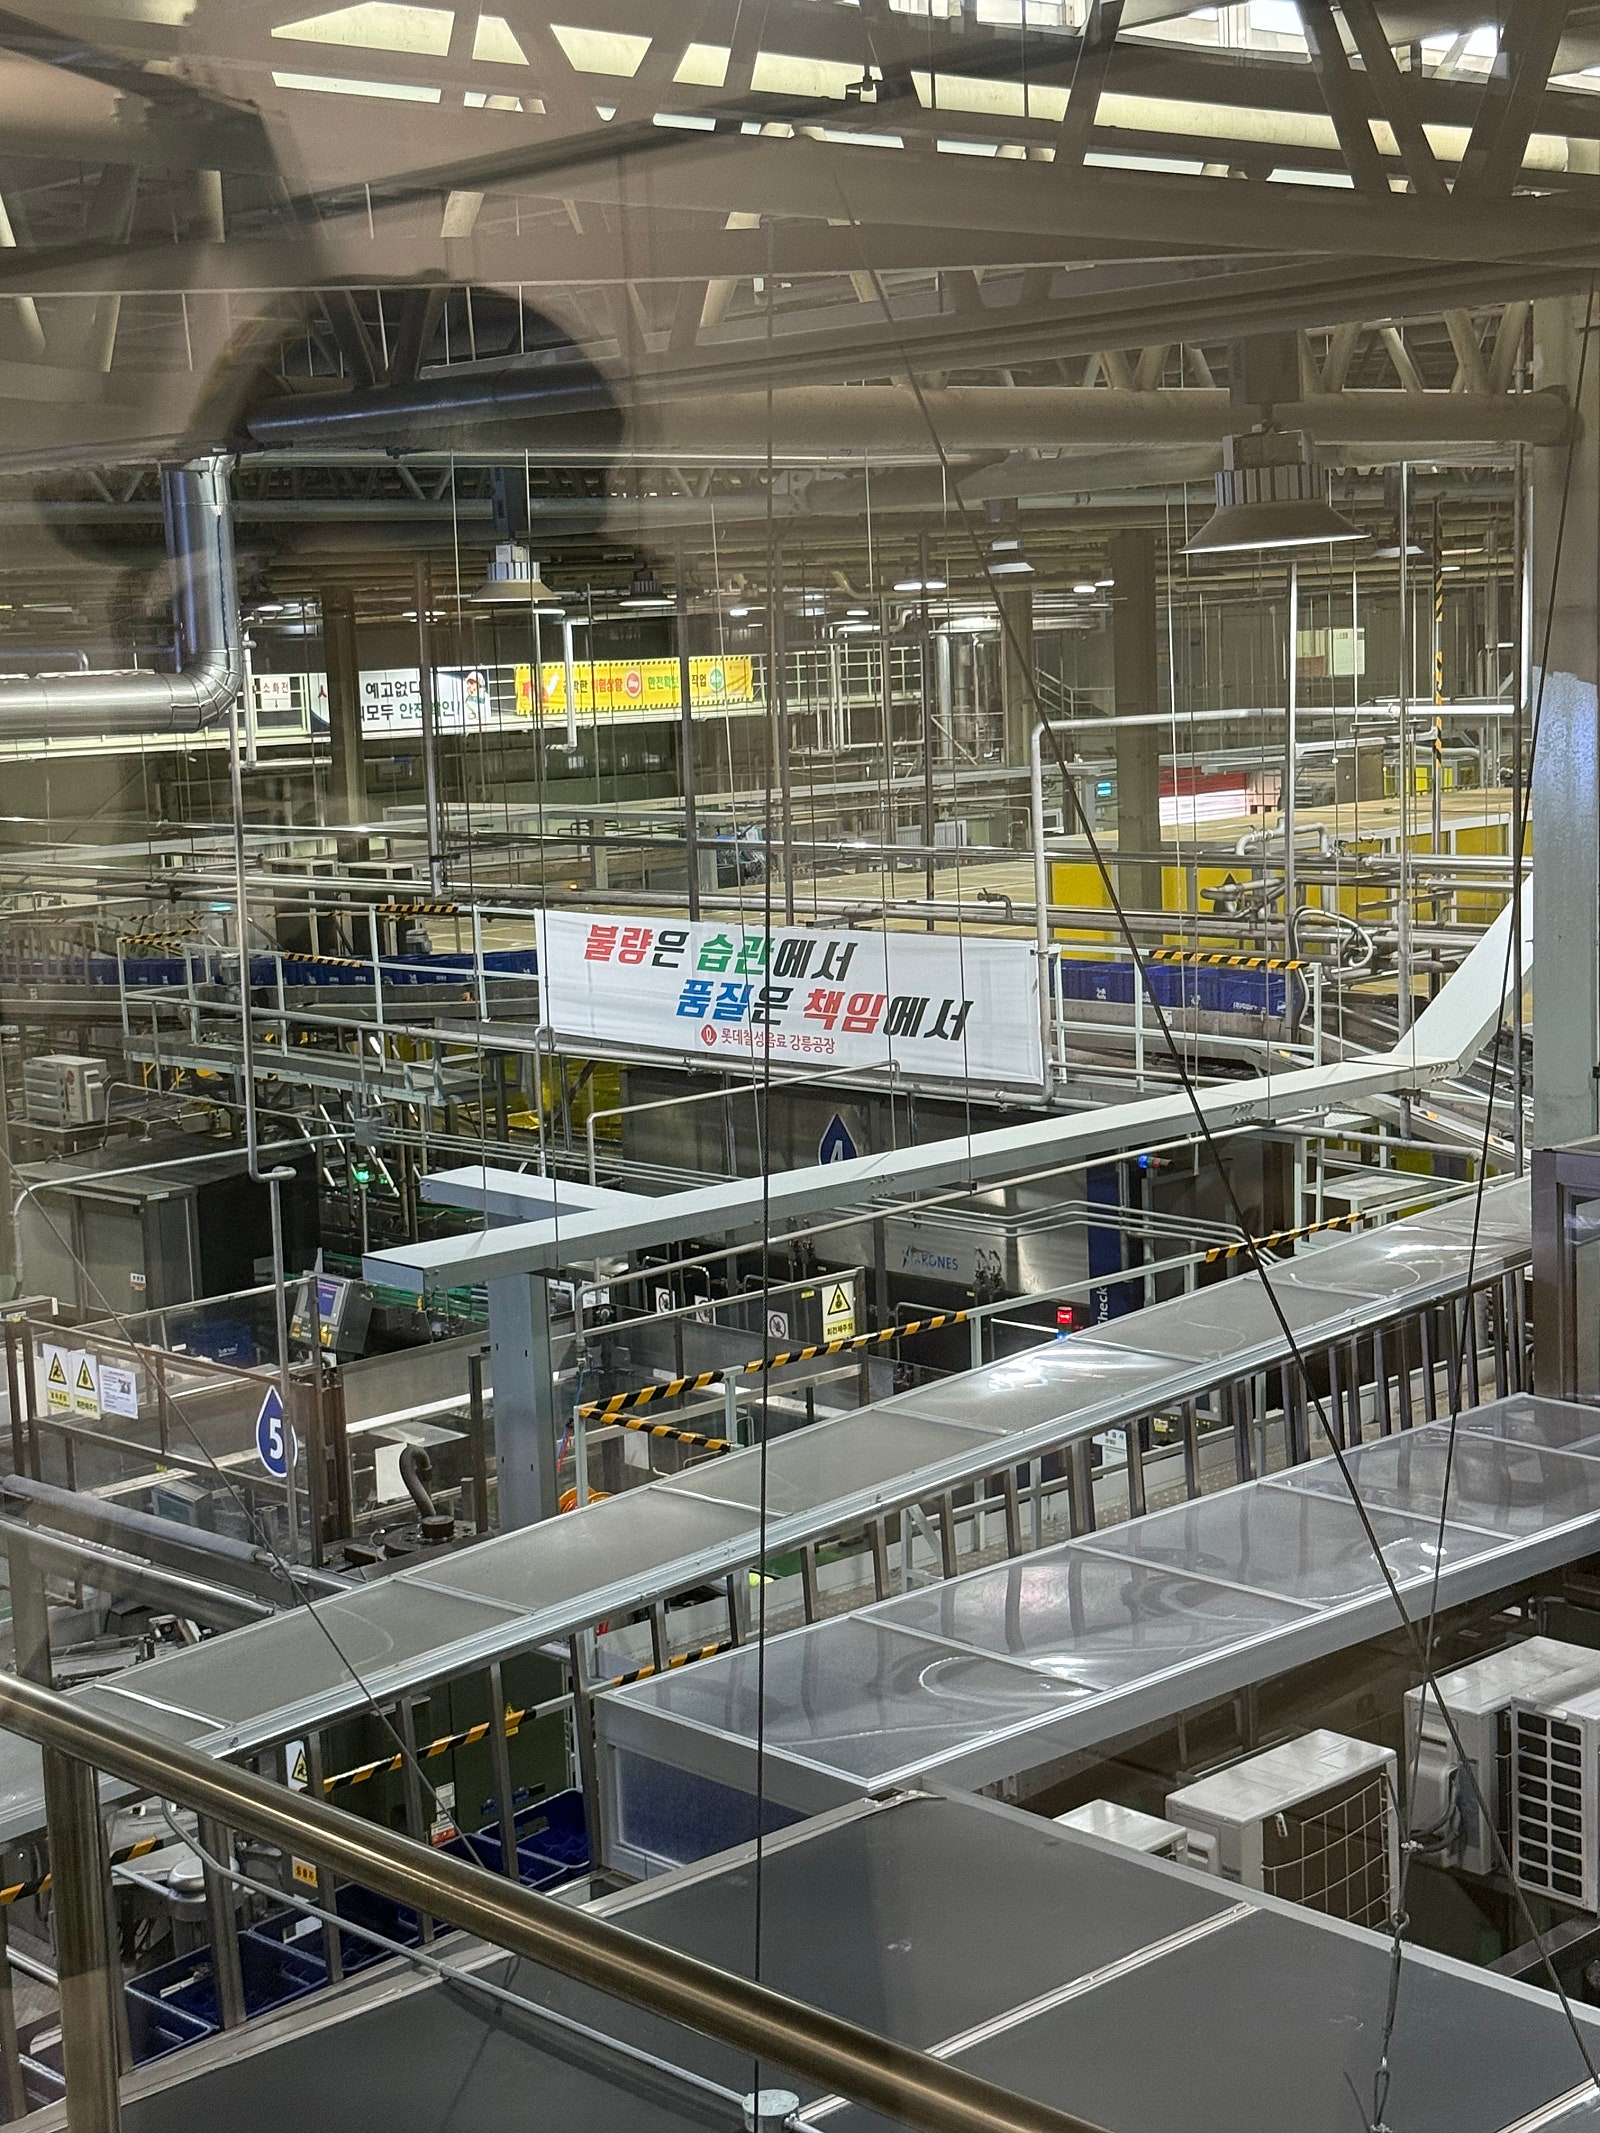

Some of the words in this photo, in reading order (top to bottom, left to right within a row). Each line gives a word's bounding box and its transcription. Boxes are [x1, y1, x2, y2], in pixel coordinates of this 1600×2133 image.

[263, 681, 289, 694] 소화전
[584, 924, 690, 969] 불량은
[696, 933, 859, 982] 습관에서
[675, 979, 794, 1026] 품질은
[803, 988, 975, 1042] 책임에서
[721, 1028, 788, 1049] 롯데칠성음료
[789, 1034, 836, 1055] 강릉공장
[912, 1250, 959, 1271] RONES
[1096, 1286, 1109, 1325] heck
[269, 1417, 284, 1460] 5
